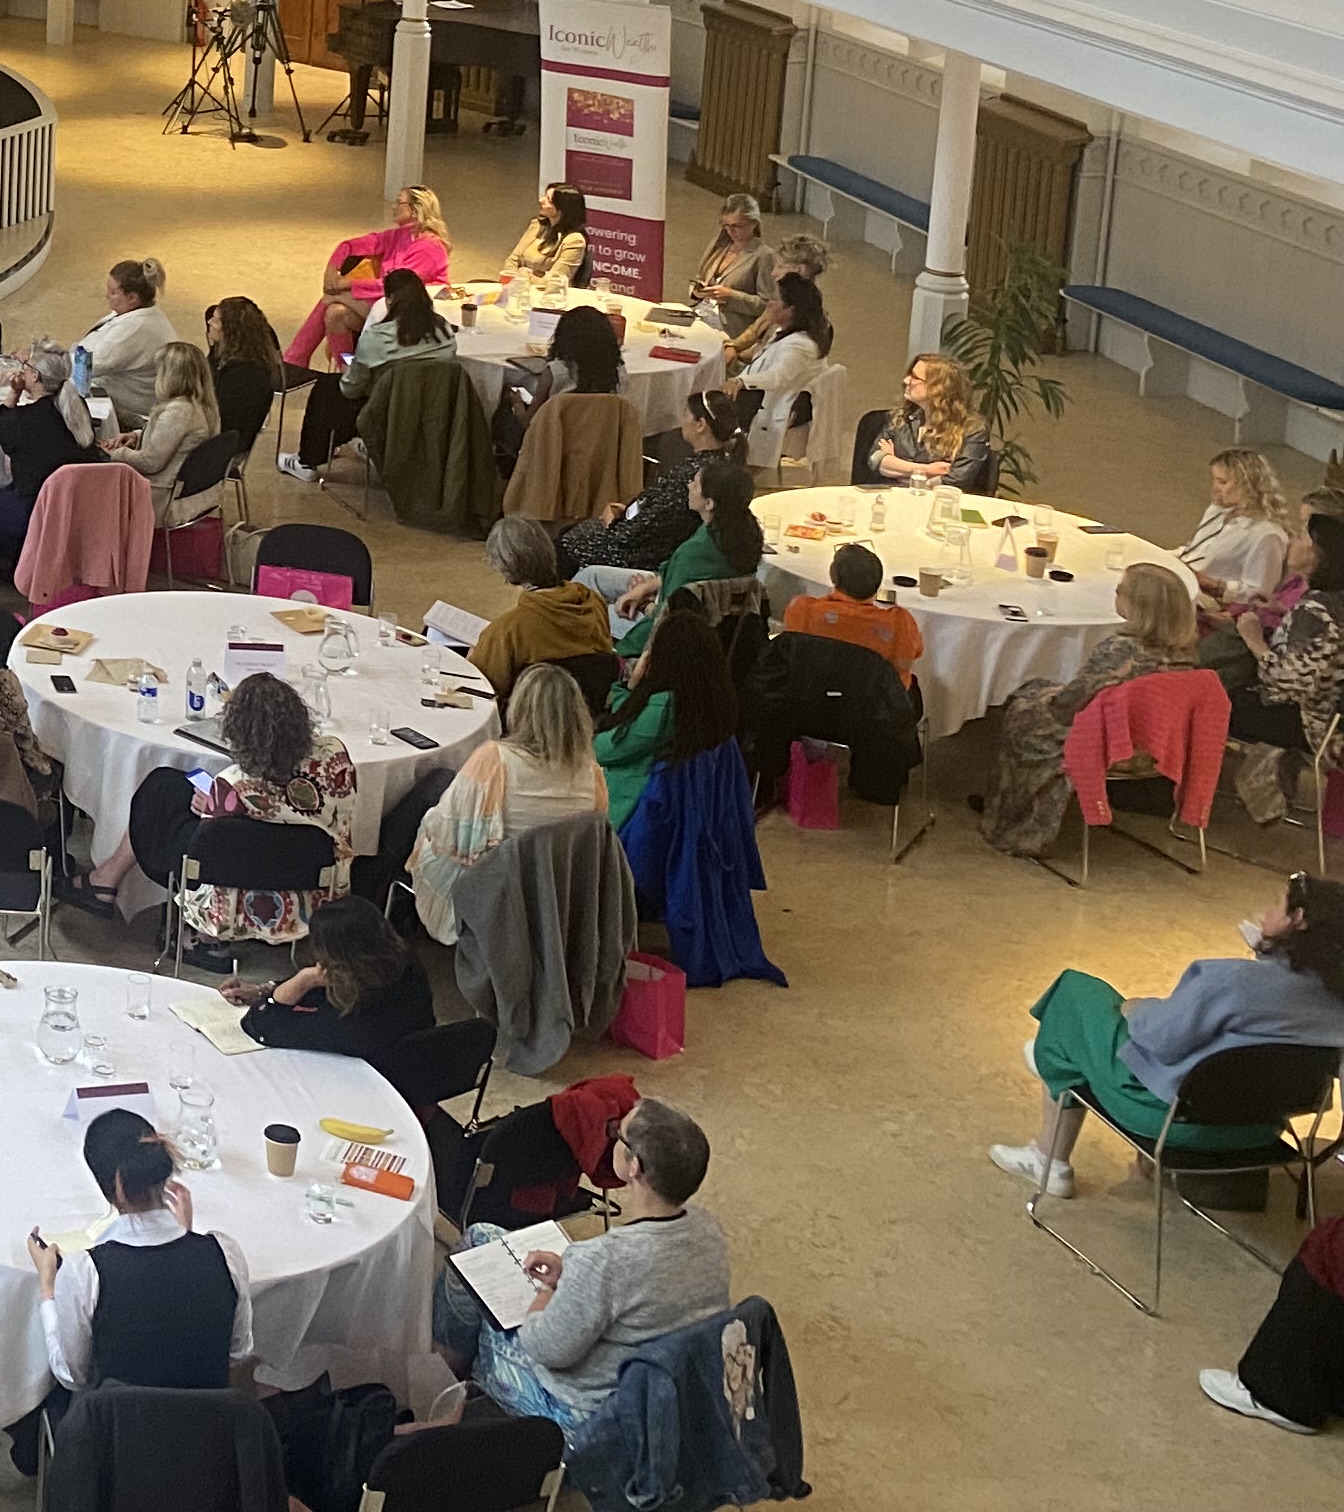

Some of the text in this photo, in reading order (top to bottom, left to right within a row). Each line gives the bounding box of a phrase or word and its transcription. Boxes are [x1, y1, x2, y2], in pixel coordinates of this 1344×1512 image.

[548, 24, 606, 47] Iconic
[598, 245, 611, 256] to
[614, 248, 646, 263] grow
